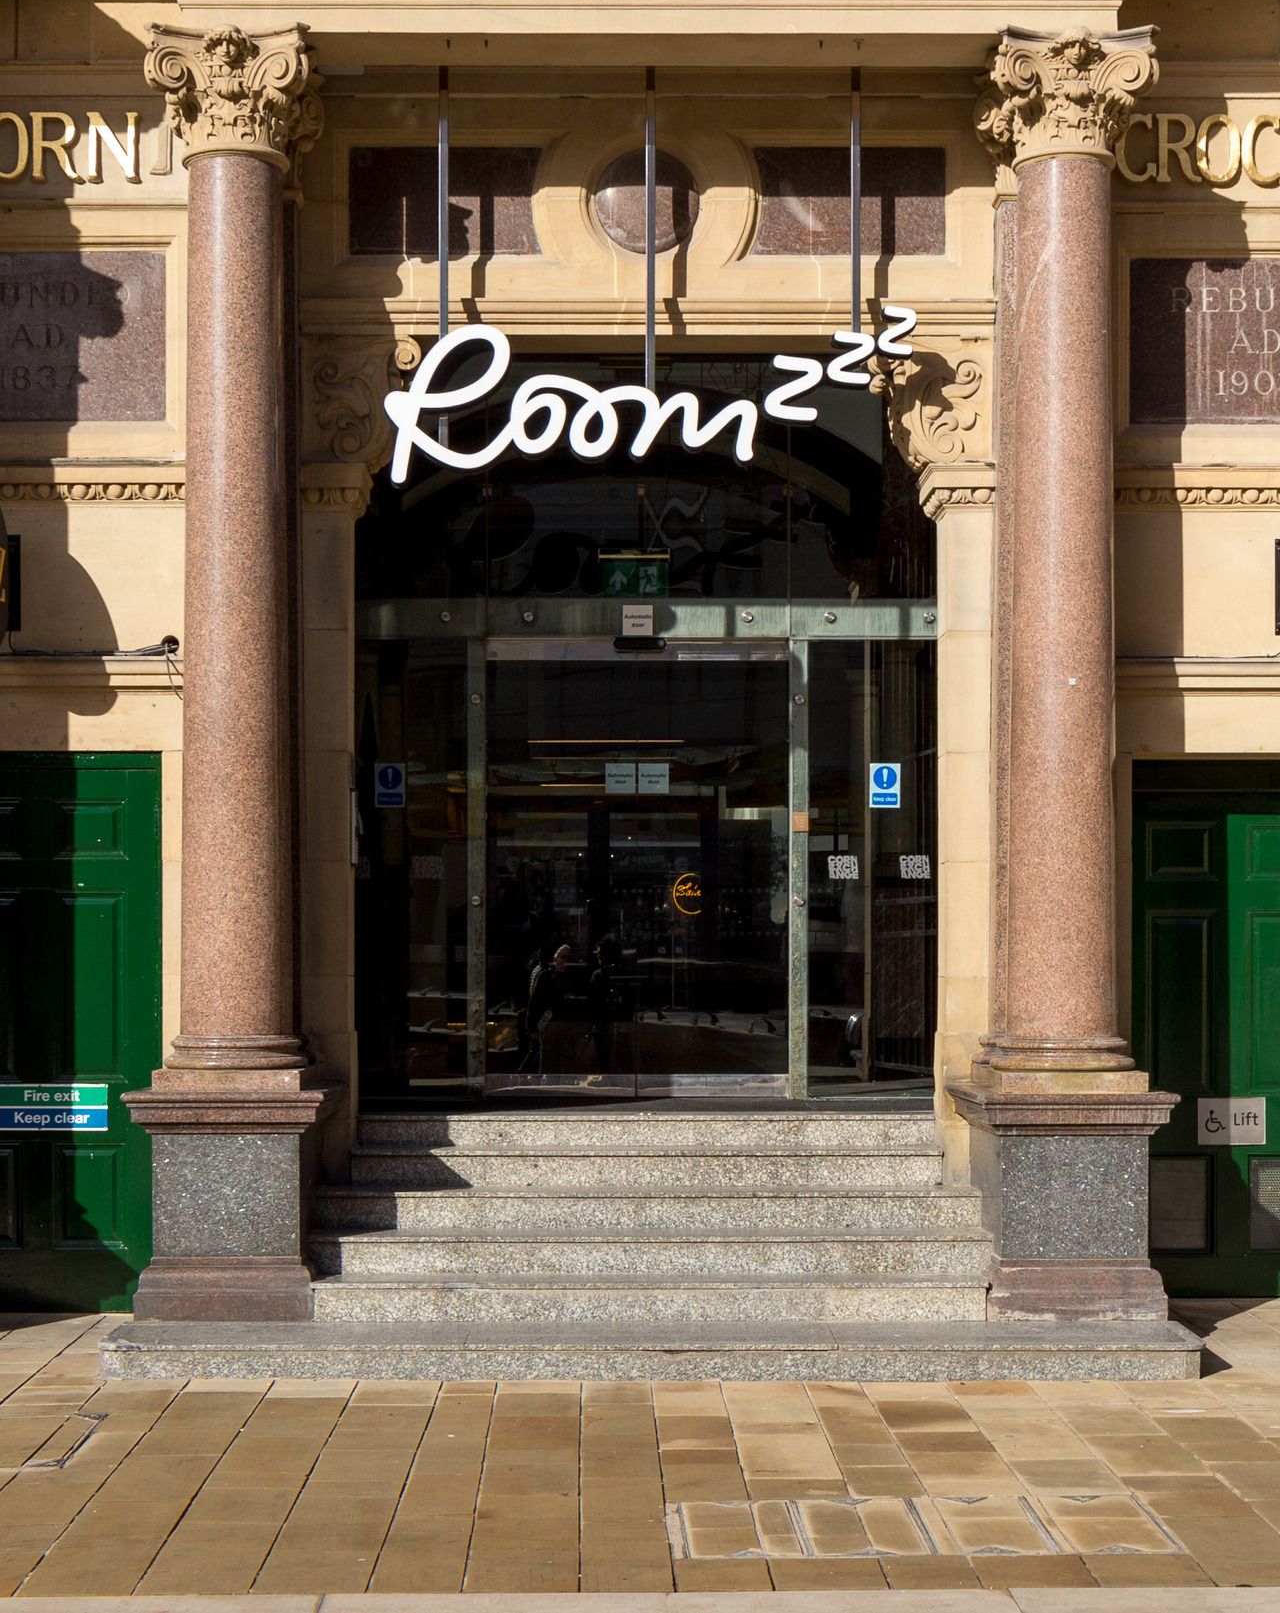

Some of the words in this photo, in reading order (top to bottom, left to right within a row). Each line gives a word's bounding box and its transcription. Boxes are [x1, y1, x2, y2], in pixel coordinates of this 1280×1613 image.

[23, 1090, 50, 1102] Fire
[54, 1090, 80, 1102] exit
[13, 1111, 51, 1126] Keep
[54, 1111, 90, 1124] clear
[1233, 1112, 1259, 1126] Lift
